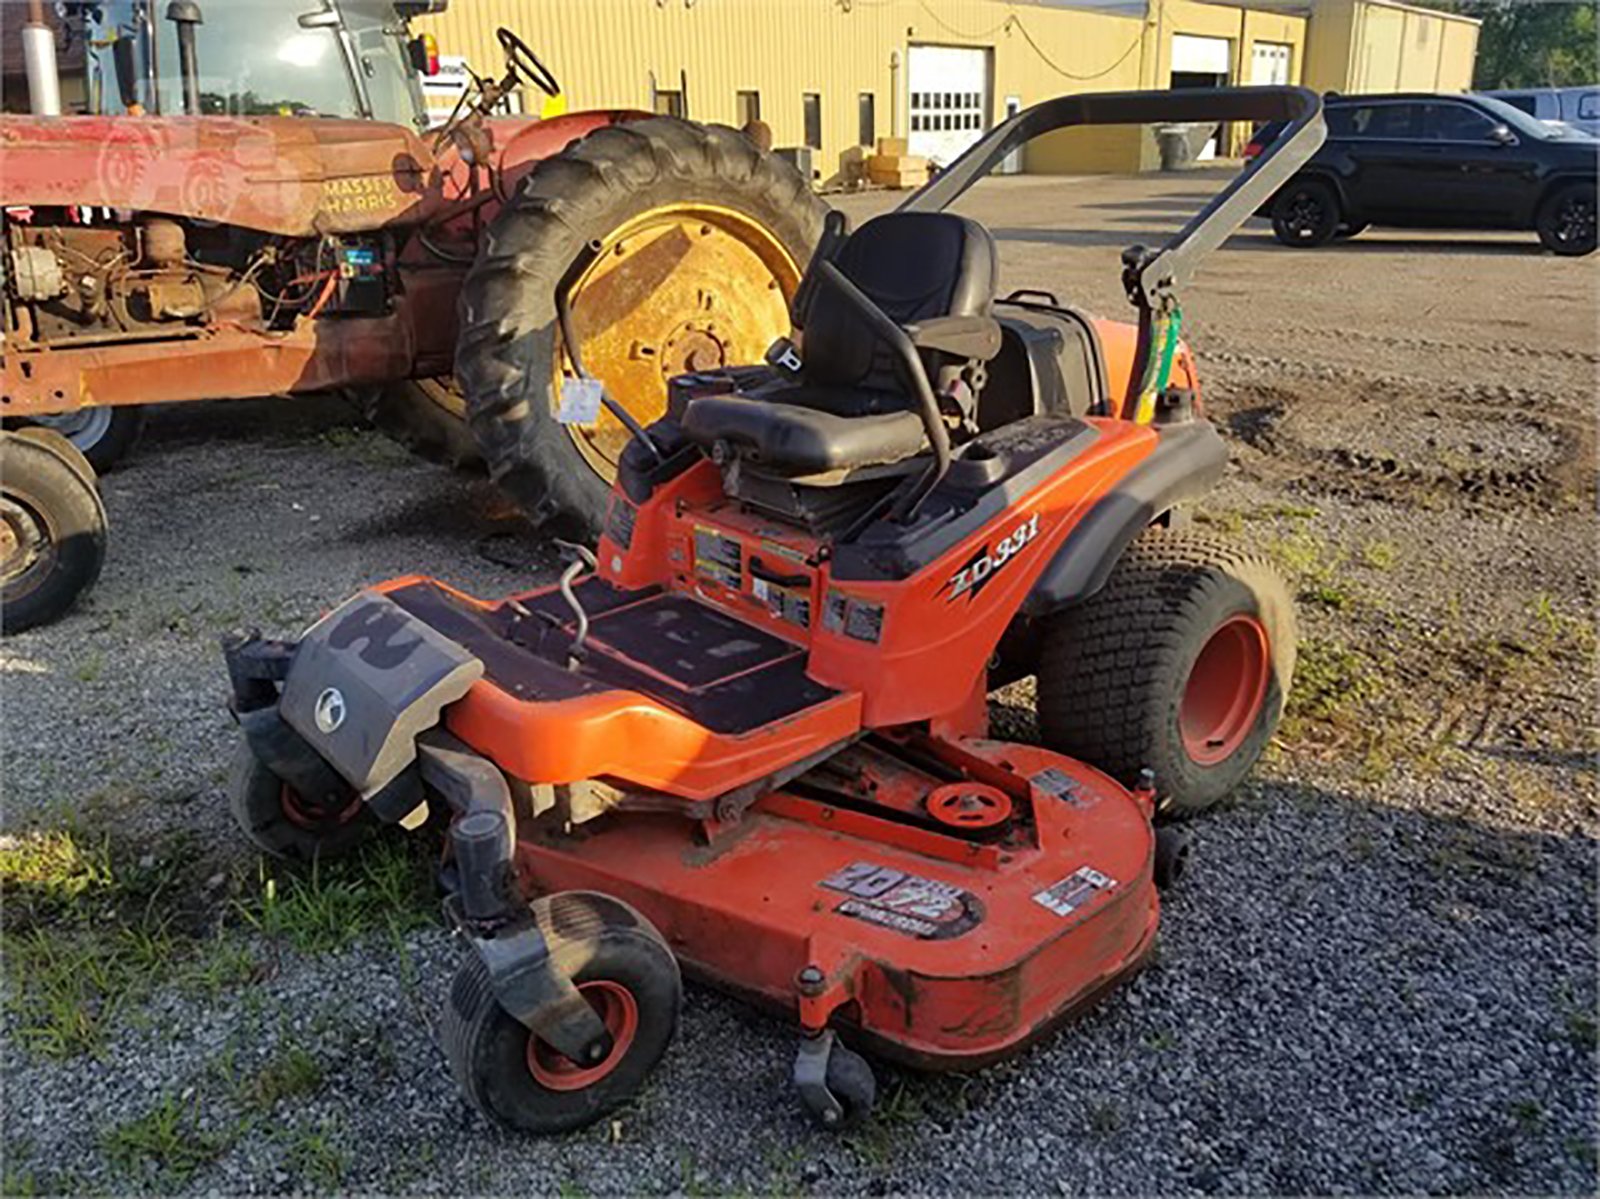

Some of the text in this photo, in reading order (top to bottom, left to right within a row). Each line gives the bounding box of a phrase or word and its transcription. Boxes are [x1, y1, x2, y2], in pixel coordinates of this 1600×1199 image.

[322, 178, 395, 196] MASSEY
[325, 193, 398, 214] HARRIS
[947, 511, 1039, 602] ZD331
